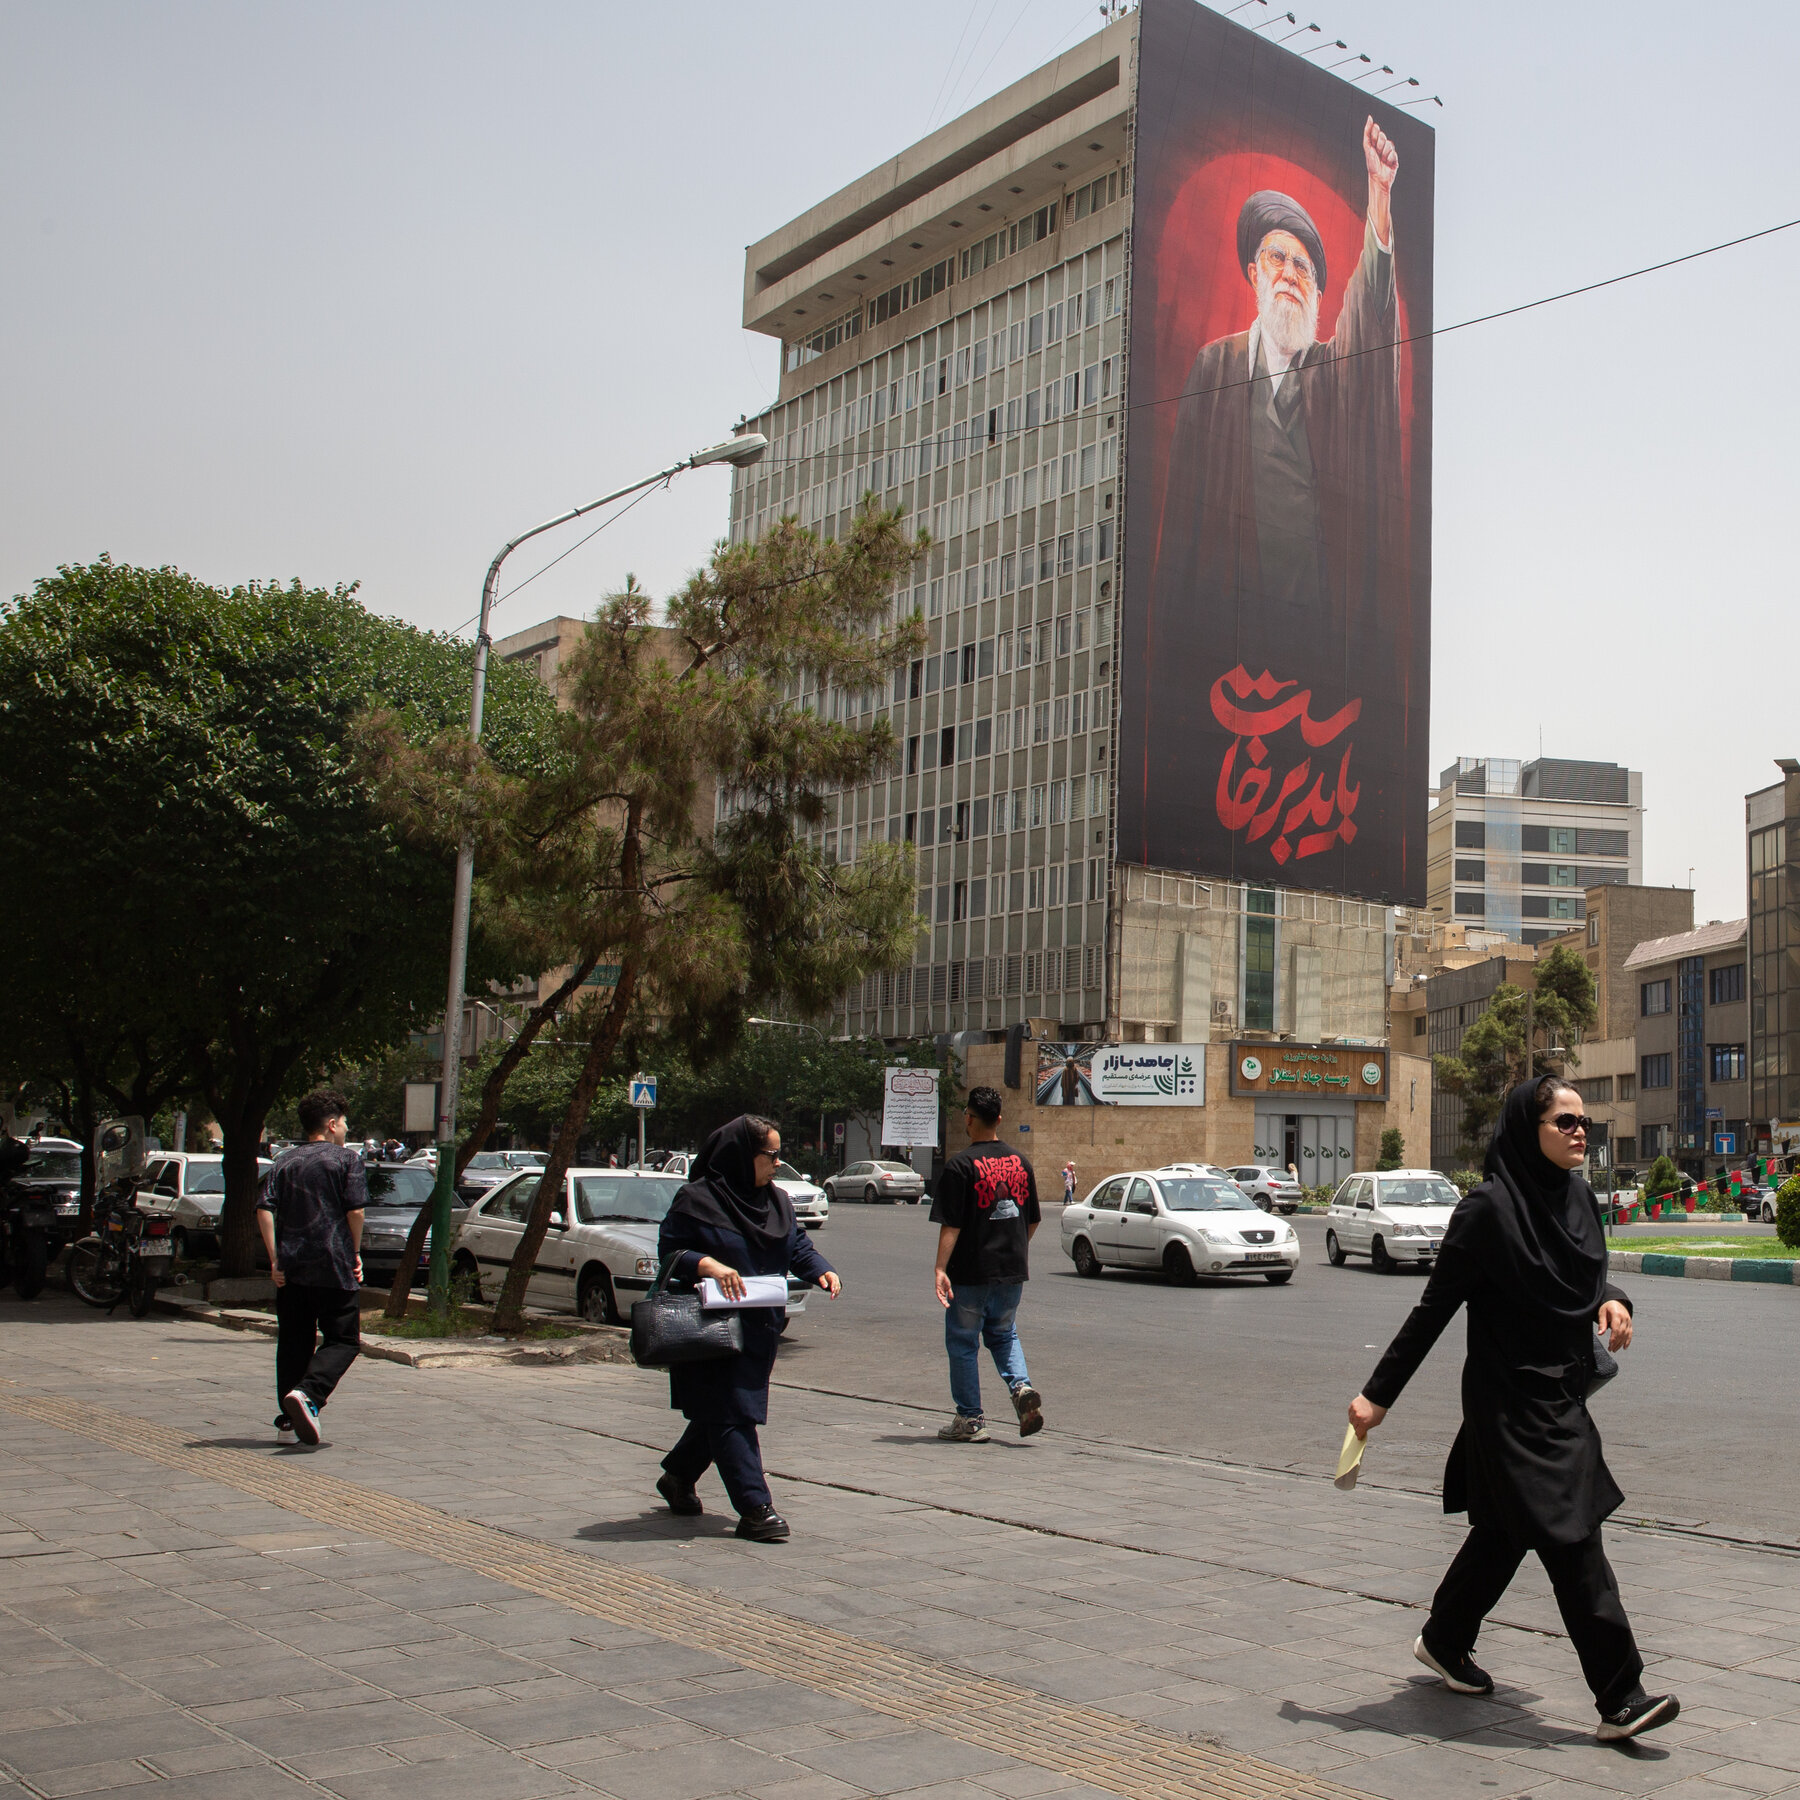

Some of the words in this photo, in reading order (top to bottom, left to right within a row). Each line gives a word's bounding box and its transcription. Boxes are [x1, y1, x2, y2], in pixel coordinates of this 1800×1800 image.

[1103, 1055, 1134, 1071] بازار
[1134, 1055, 1174, 1071] جاهد
[1102, 1073, 1128, 1081] مستقیم
[1269, 1067, 1300, 1084] استقلال
[1303, 1069, 1322, 1087] جهاد
[1324, 1072, 1350, 1087] موسسه
[973, 1154, 1024, 1179] NEVER
